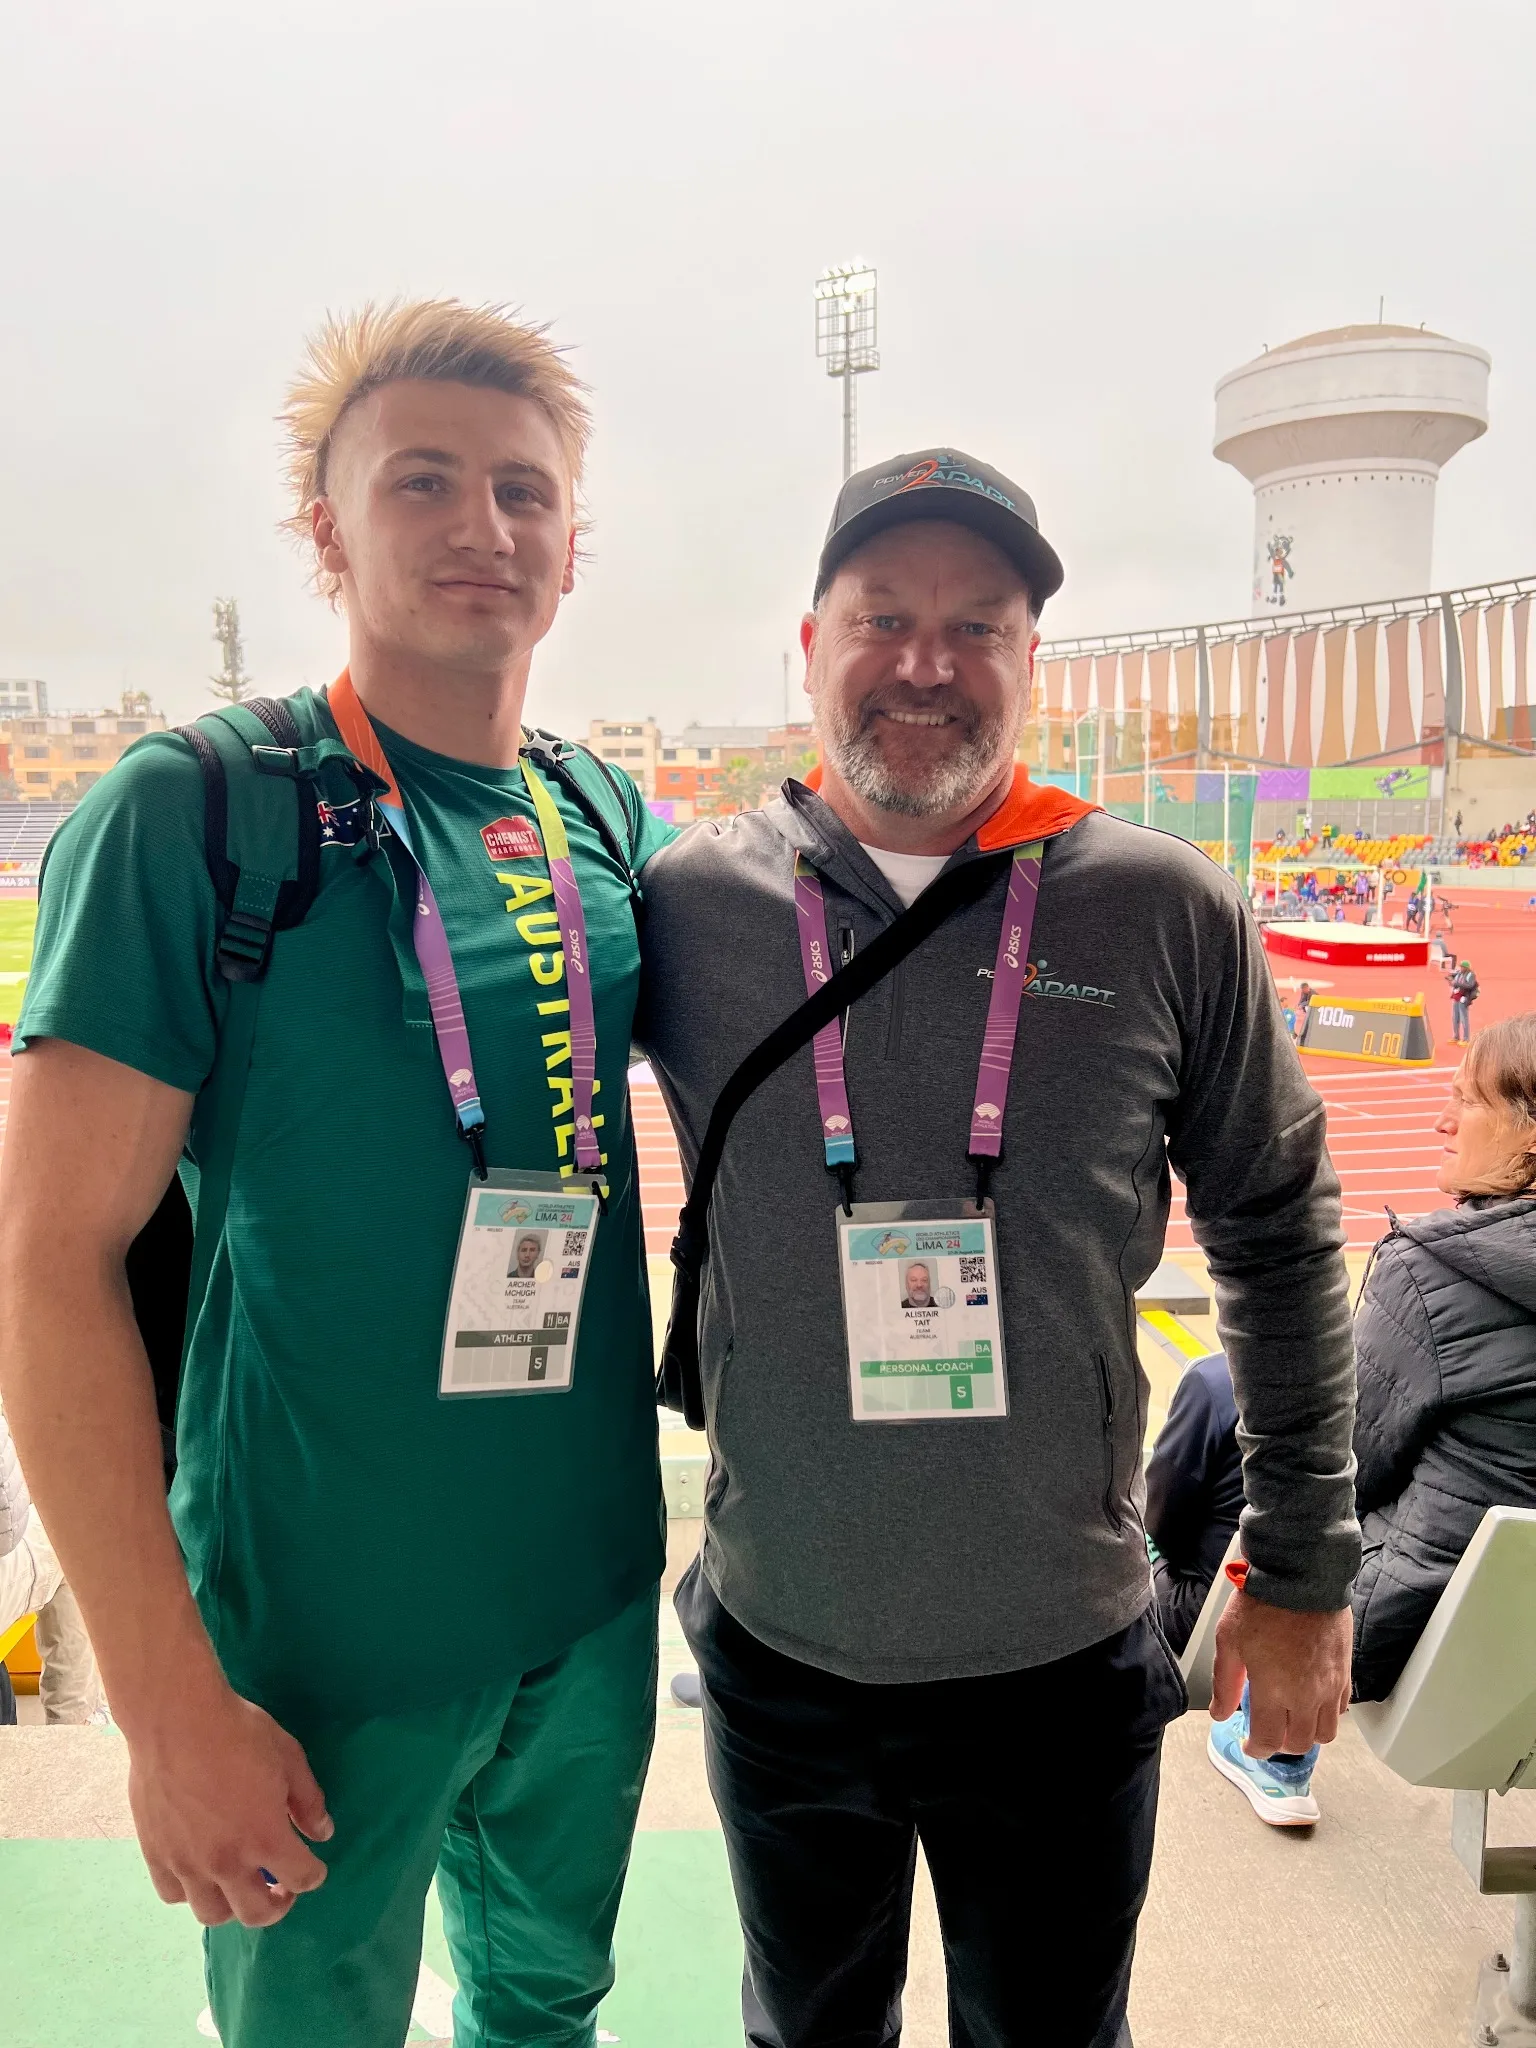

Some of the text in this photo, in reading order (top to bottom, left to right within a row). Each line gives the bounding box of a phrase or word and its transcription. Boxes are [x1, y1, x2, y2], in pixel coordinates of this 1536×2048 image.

[872, 469, 928, 489] POWER
[927, 470, 1016, 509] ADAPT
[485, 830, 535, 847] CHEMIST
[490, 845, 538, 855] WAREHOUSE
[1024, 979, 1116, 1003] ADAPT
[1318, 1006, 1355, 1028] 100m
[1362, 1030, 1401, 1058] 0.00
[535, 1212, 573, 1222] LIMA 24
[916, 1240, 961, 1250] LIMA 24
[504, 1289, 536, 1297] MCHUGH
[904, 1310, 939, 1318] ALISTAIR
[493, 1333, 533, 1344] ATHLETE
[975, 1343, 990, 1353] BA
[879, 1361, 974, 1374] PERSONAL COACH
